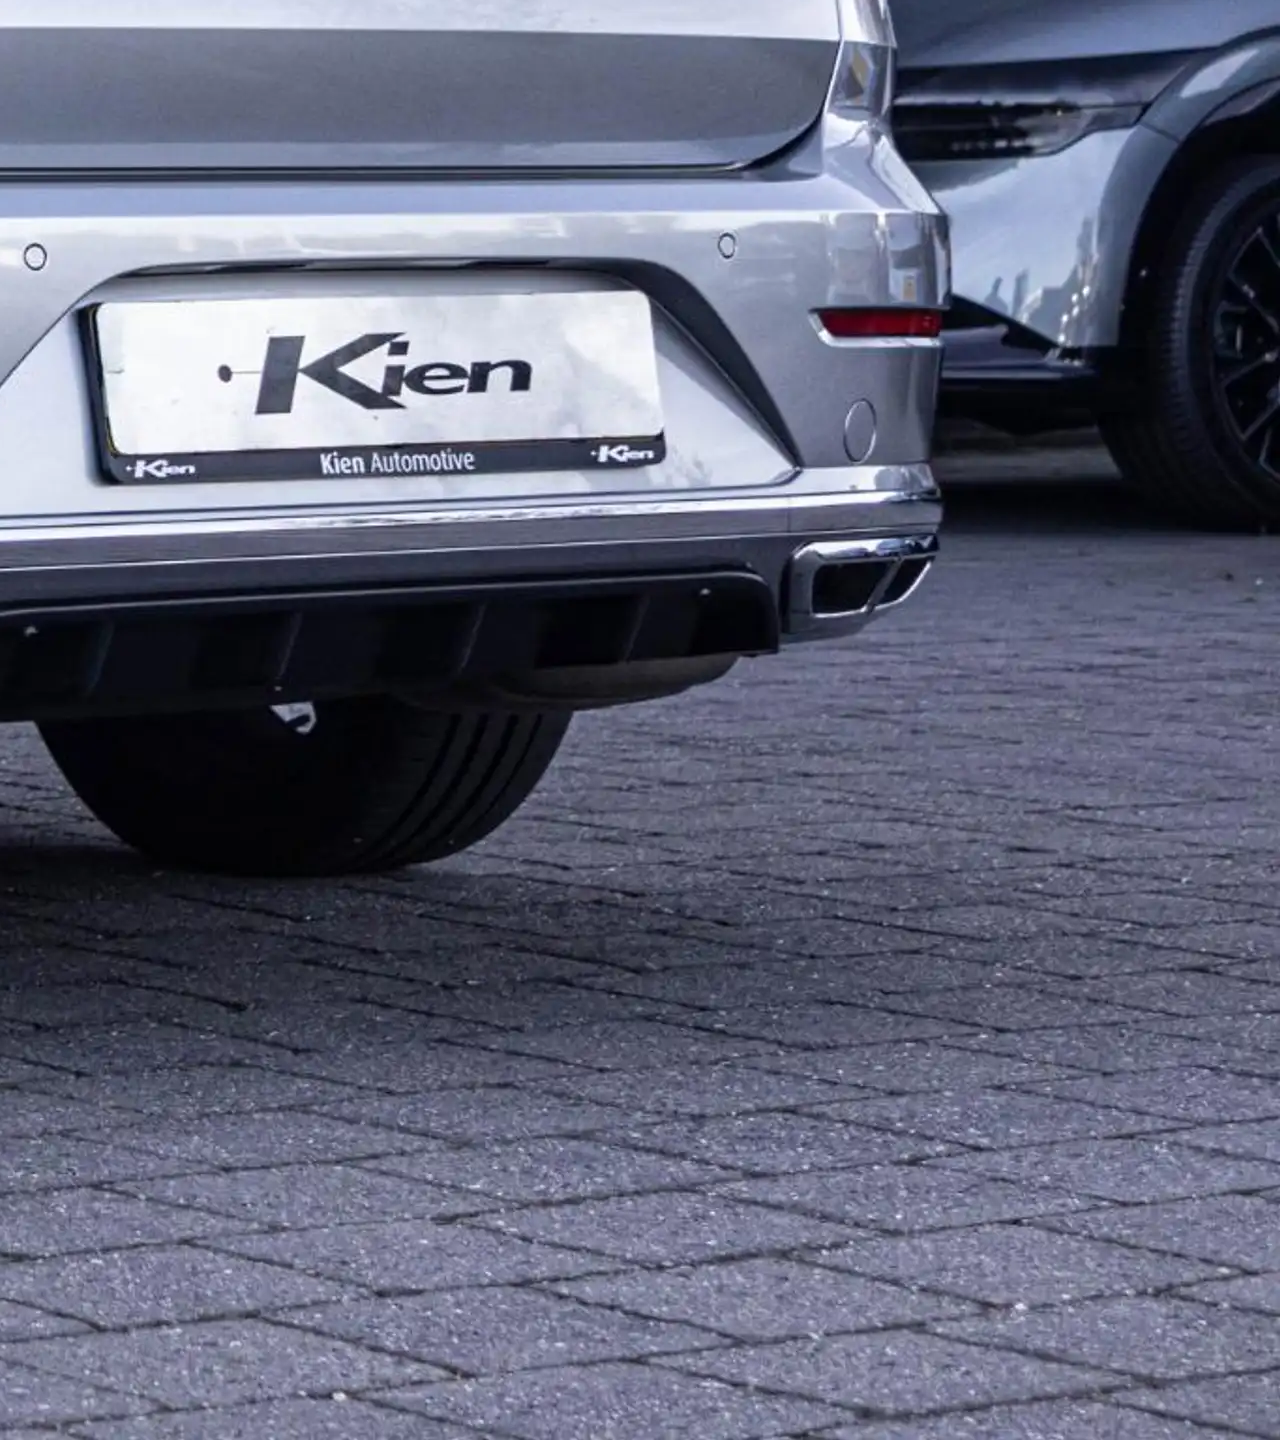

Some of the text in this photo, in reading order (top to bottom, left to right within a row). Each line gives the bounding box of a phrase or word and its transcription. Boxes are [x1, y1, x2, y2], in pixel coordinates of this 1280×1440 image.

[255, 332, 532, 415] Kien
[320, 447, 475, 475] Kien Automotive
